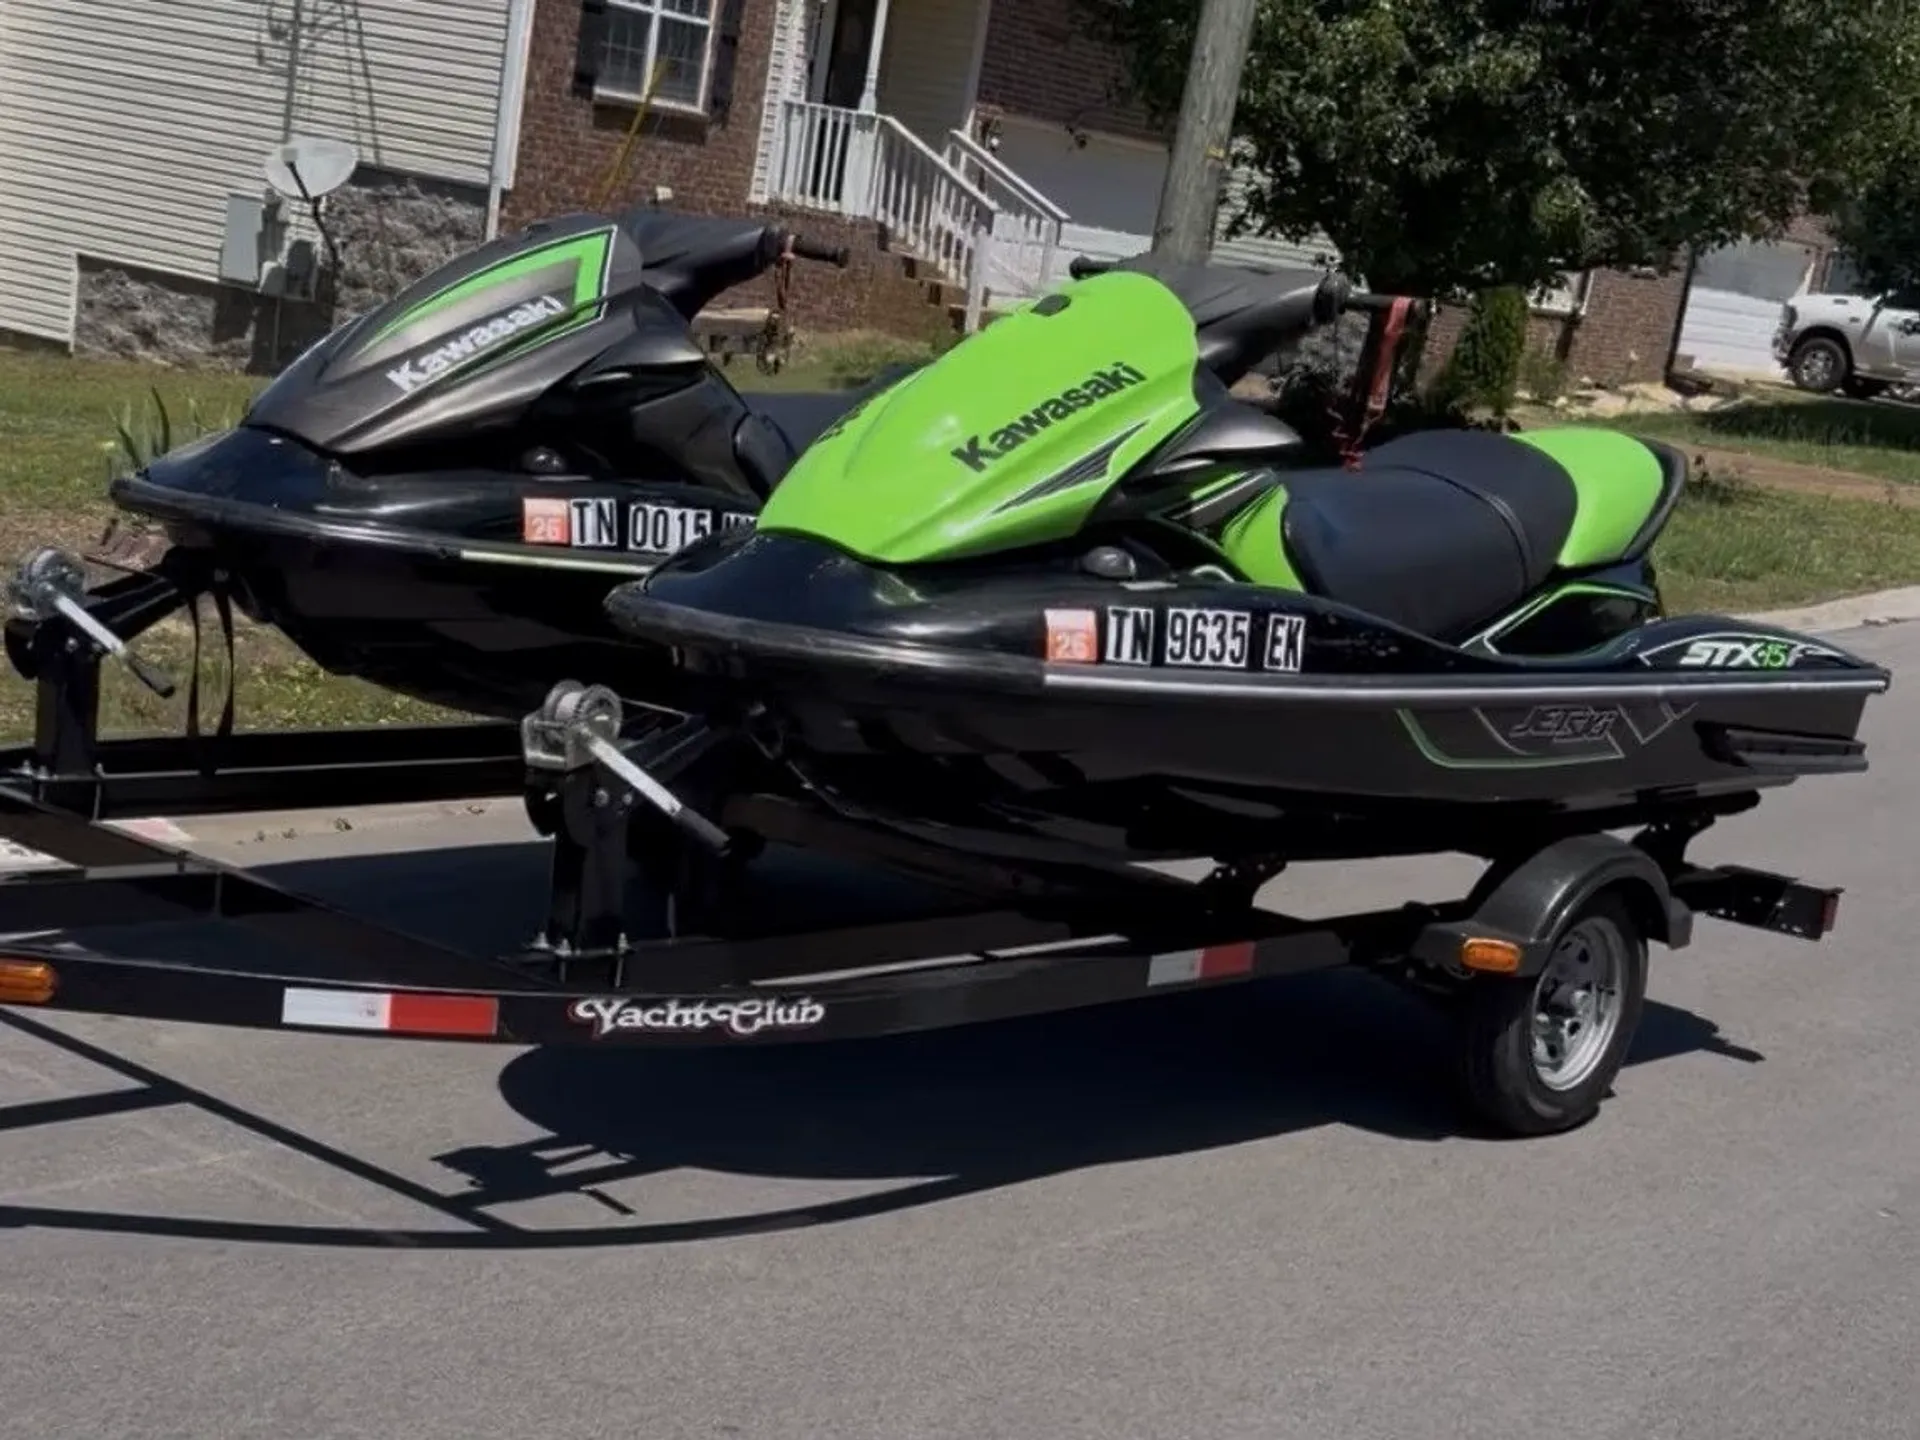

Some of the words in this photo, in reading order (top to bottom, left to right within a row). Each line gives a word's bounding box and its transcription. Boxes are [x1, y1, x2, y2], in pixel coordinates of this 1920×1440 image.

[386, 295, 566, 391] Kawasaki
[951, 361, 1147, 472] Kawasaki
[572, 501, 615, 544] TN
[631, 504, 711, 549] 0015
[1110, 609, 1152, 662] TN
[1168, 611, 1248, 665] 9635
[1266, 616, 1303, 670] EK
[574, 999, 709, 1035] Yacht
[707, 999, 825, 1034] Club
